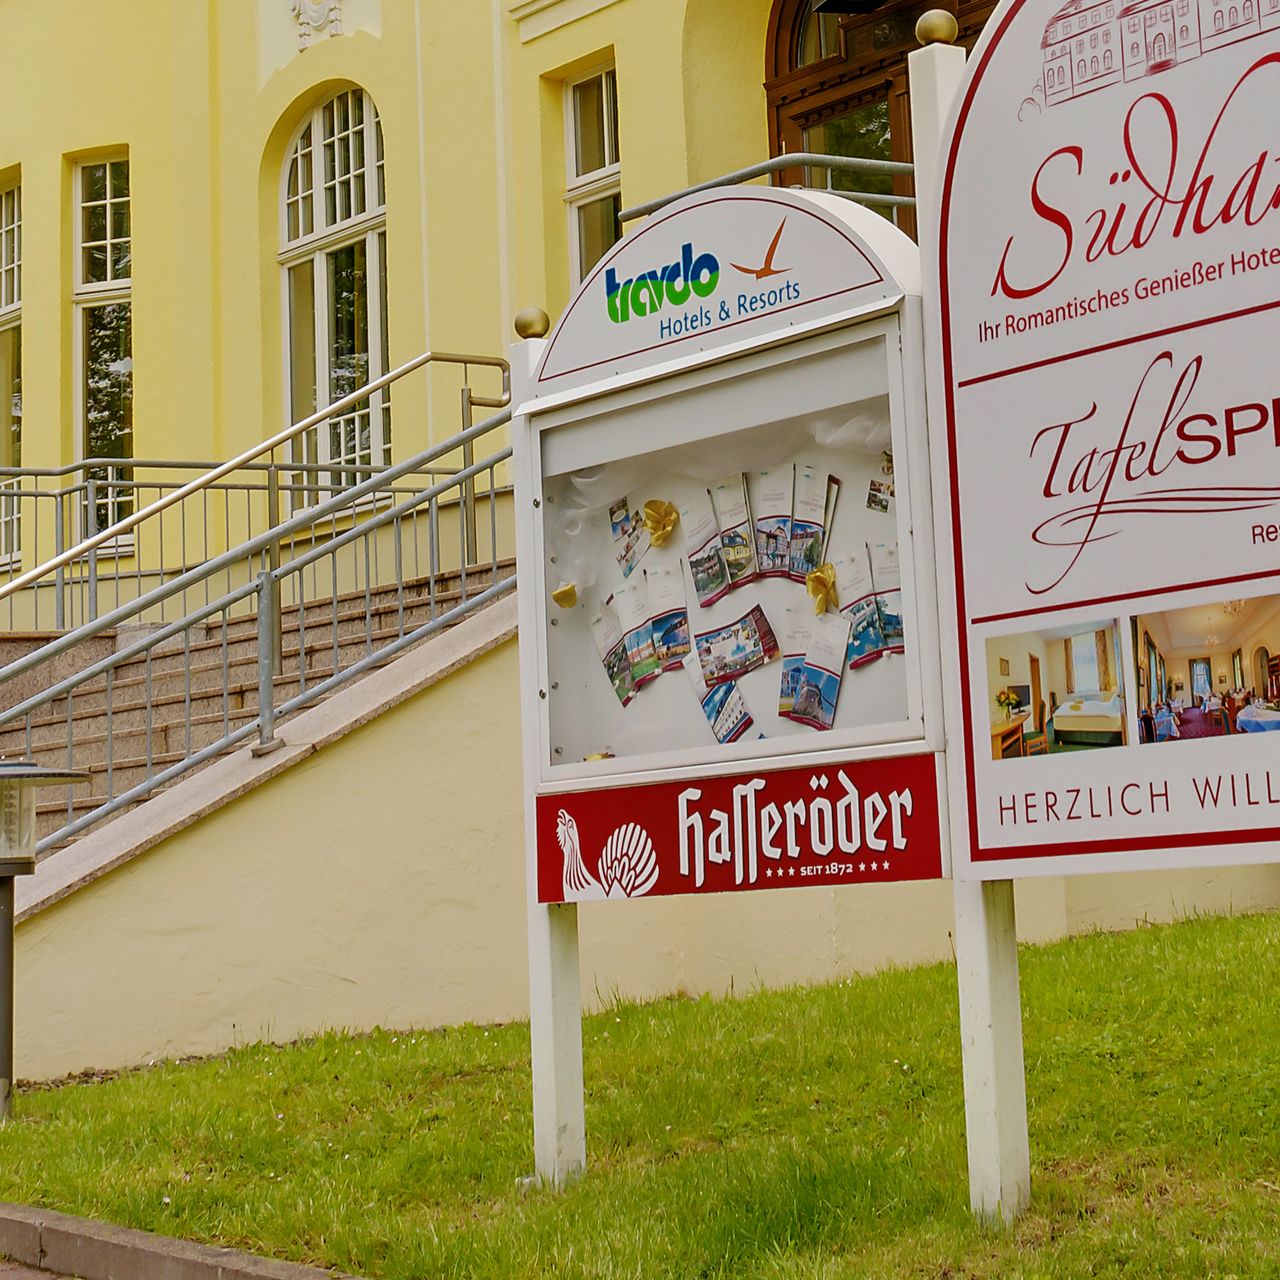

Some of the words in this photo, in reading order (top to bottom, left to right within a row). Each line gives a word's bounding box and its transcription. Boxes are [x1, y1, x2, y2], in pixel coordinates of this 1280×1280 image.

[605, 241, 720, 324] travdo
[659, 307, 712, 338] Hotels
[718, 300, 732, 321] &
[736, 279, 801, 315] Resorts
[978, 321, 1001, 343] Ihr
[1005, 288, 1130, 336] Romantisches
[1134, 260, 1225, 298] Genießer
[998, 781, 1170, 826] HERZLICH
[799, 864, 823, 876] SEIT
[824, 861, 854, 875] 1872
